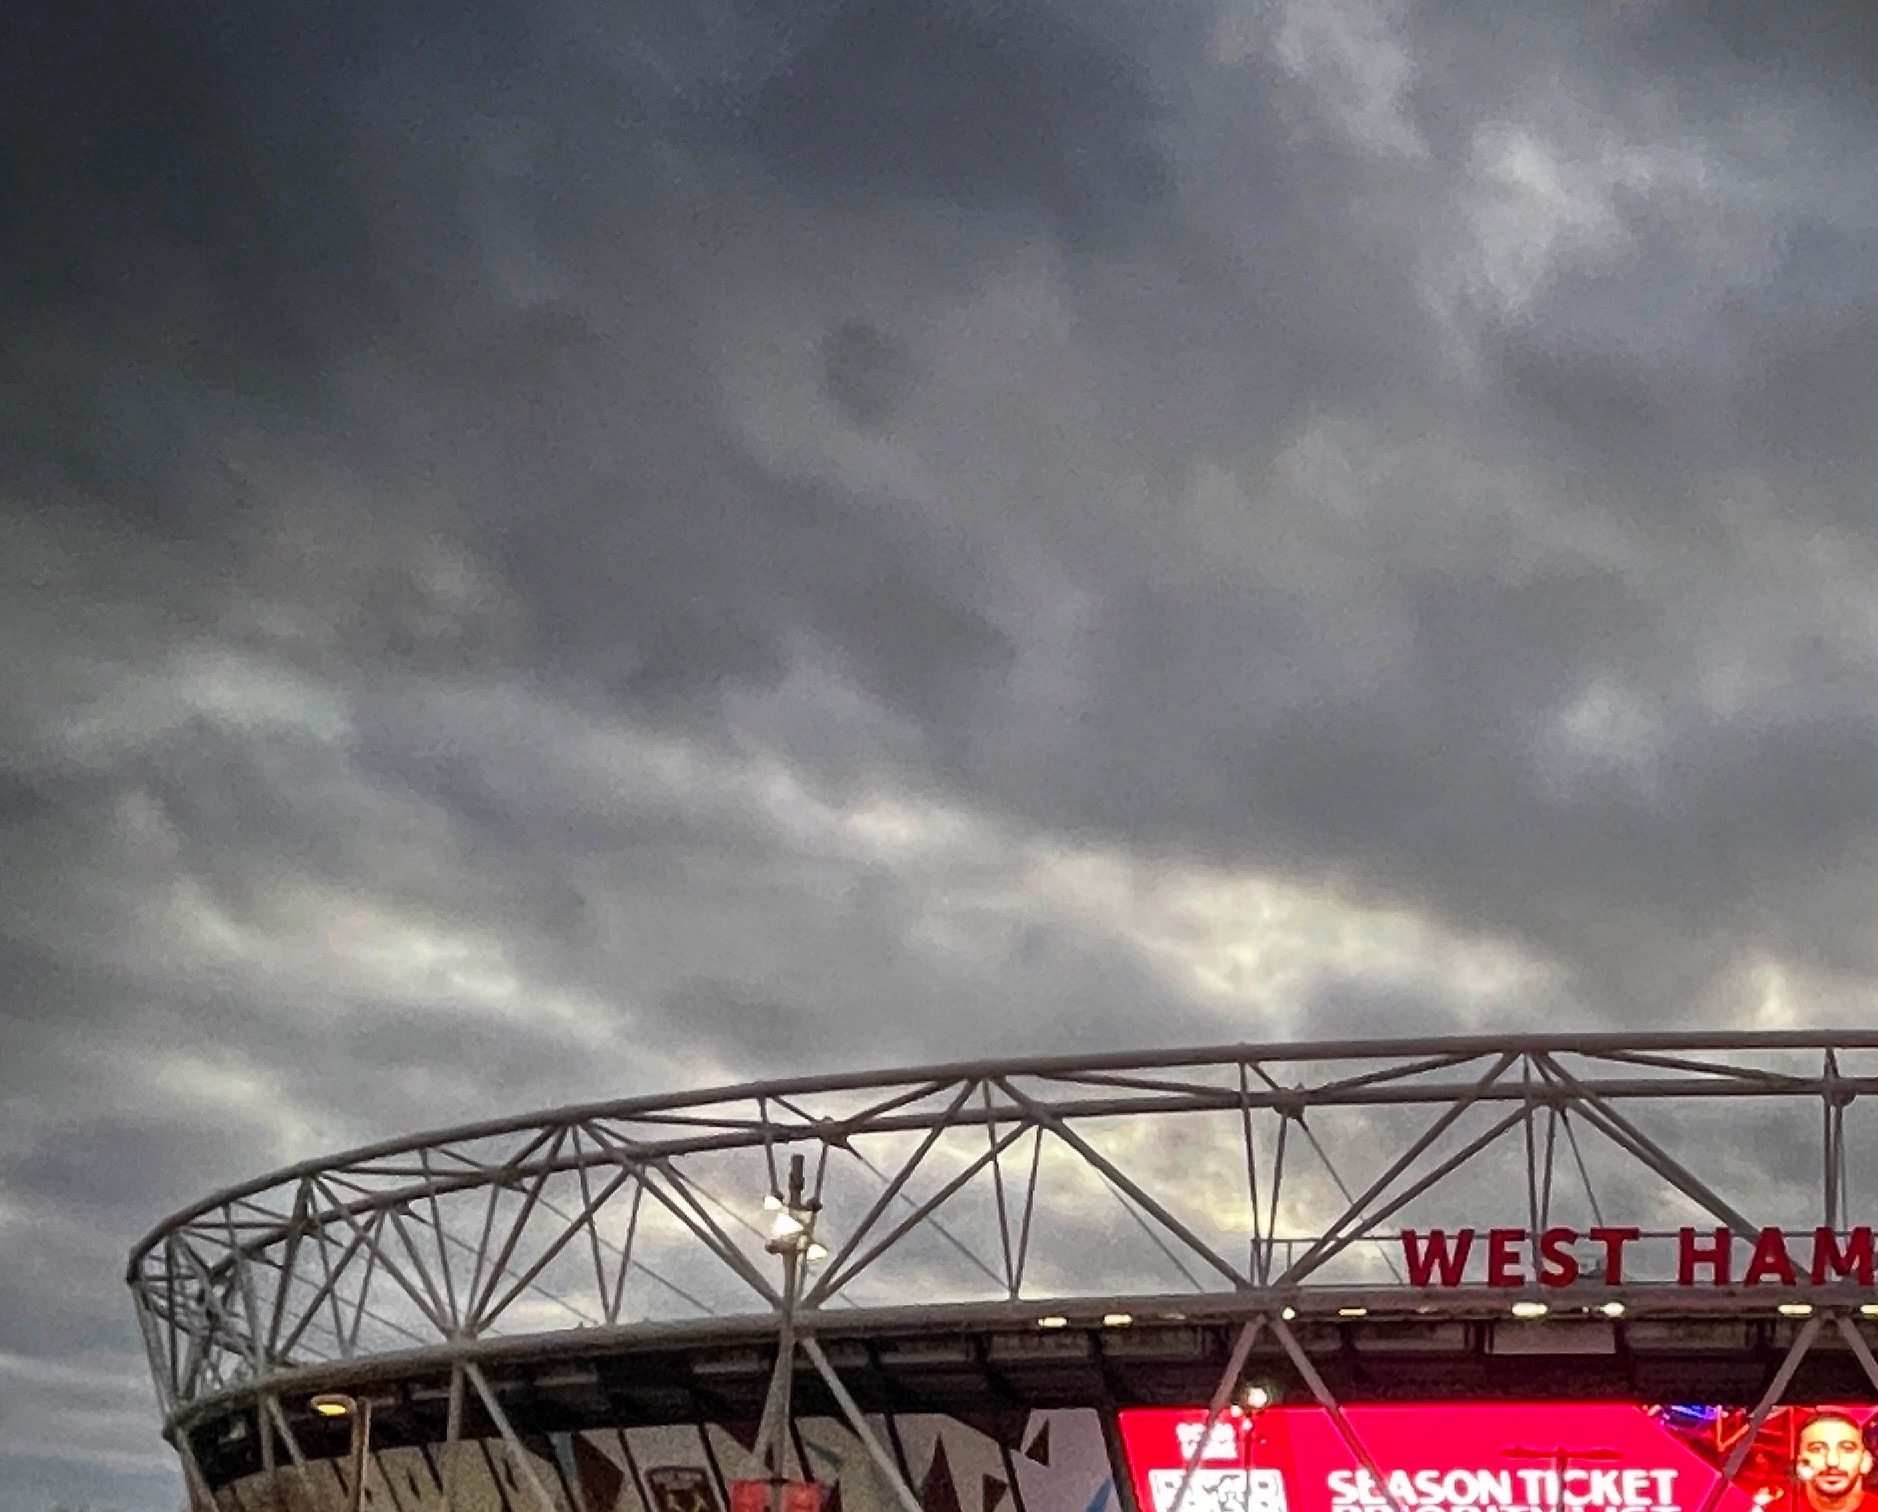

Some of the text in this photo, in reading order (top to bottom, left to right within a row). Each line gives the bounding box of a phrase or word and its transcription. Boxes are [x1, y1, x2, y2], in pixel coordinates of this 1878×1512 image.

[1400, 1227, 1640, 1288] WEST
[1677, 1226, 1876, 1287] HAM
[1517, 1468, 1679, 1506] TICKET
